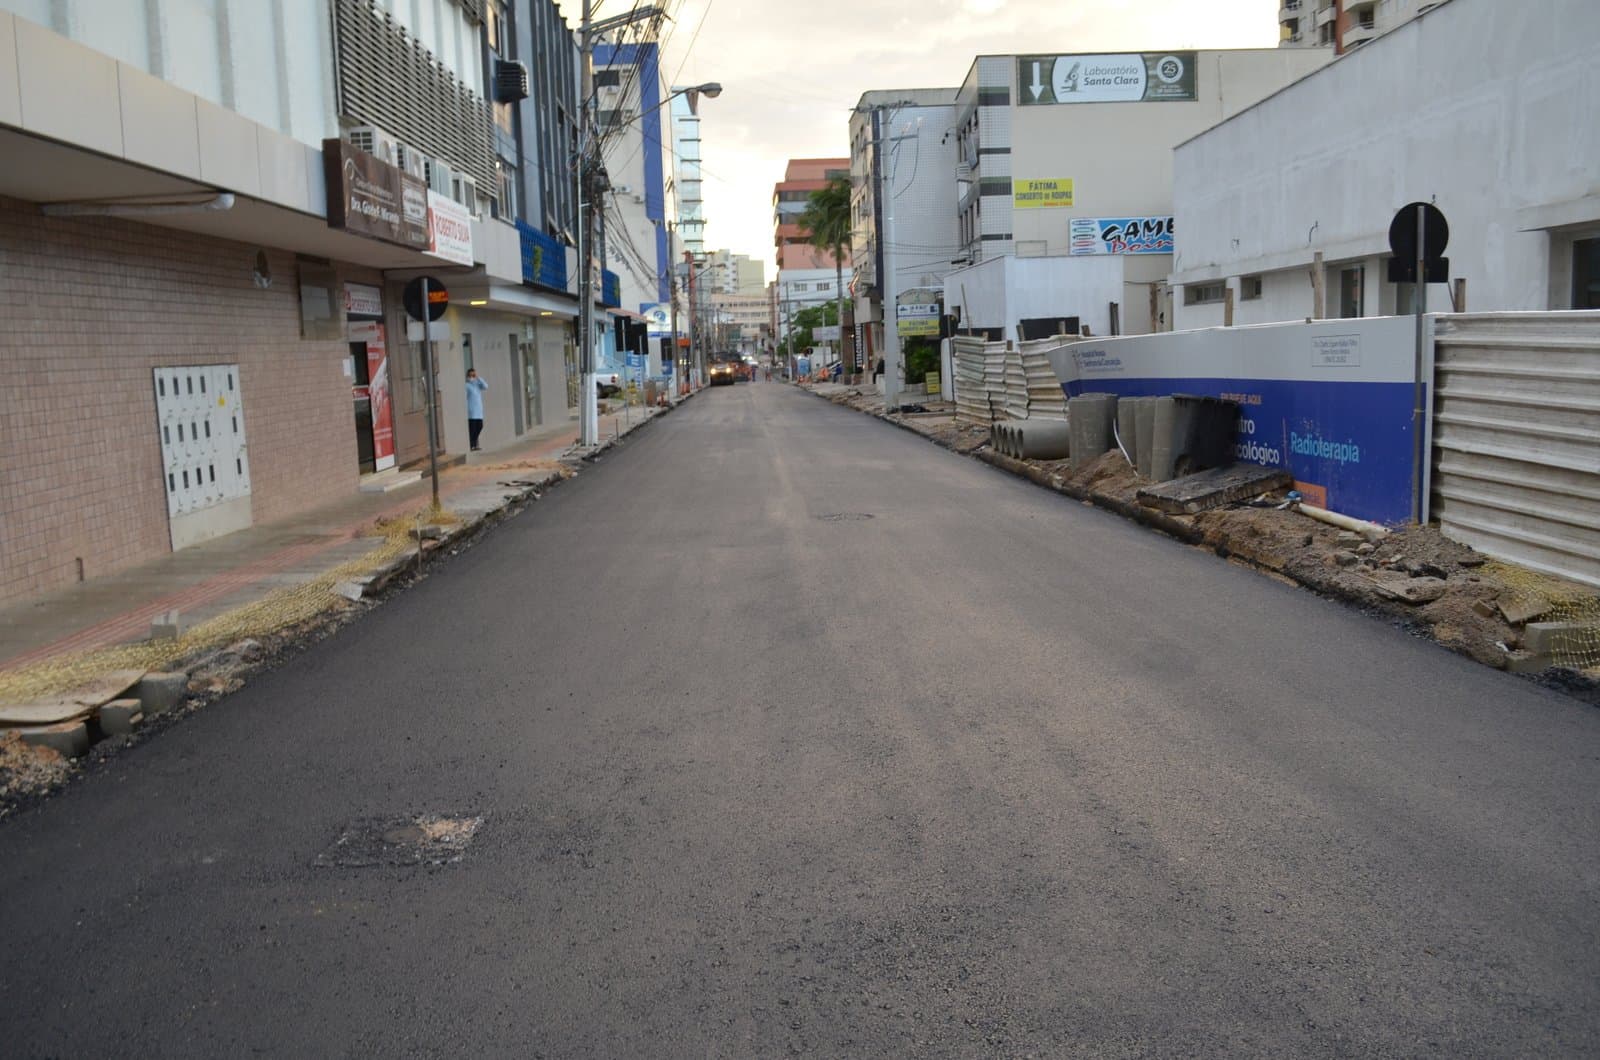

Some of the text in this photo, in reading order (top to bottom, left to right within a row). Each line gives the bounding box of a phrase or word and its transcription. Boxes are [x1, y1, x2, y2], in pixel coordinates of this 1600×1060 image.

[1084, 65, 1138, 76] Laboratório
[1164, 63, 1176, 74] 25
[1083, 75, 1139, 86] Santa Clara
[1233, 441, 1280, 465] cológico
[1290, 432, 1359, 465] Radioterapia
